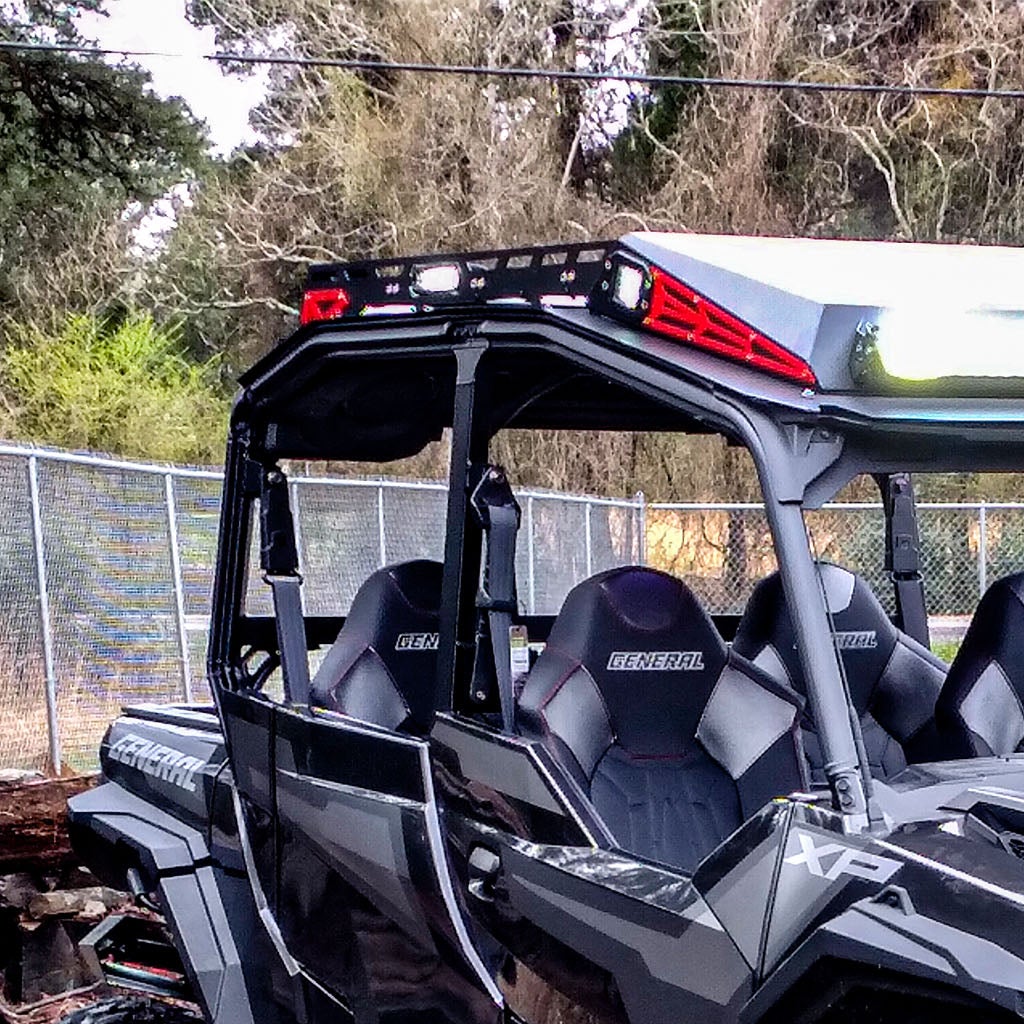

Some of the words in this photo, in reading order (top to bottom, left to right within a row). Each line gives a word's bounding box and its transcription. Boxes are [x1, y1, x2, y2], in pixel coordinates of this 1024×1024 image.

[606, 651, 705, 671] GENERAL
[108, 733, 206, 792] GENERAL
[783, 833, 905, 884] XP
